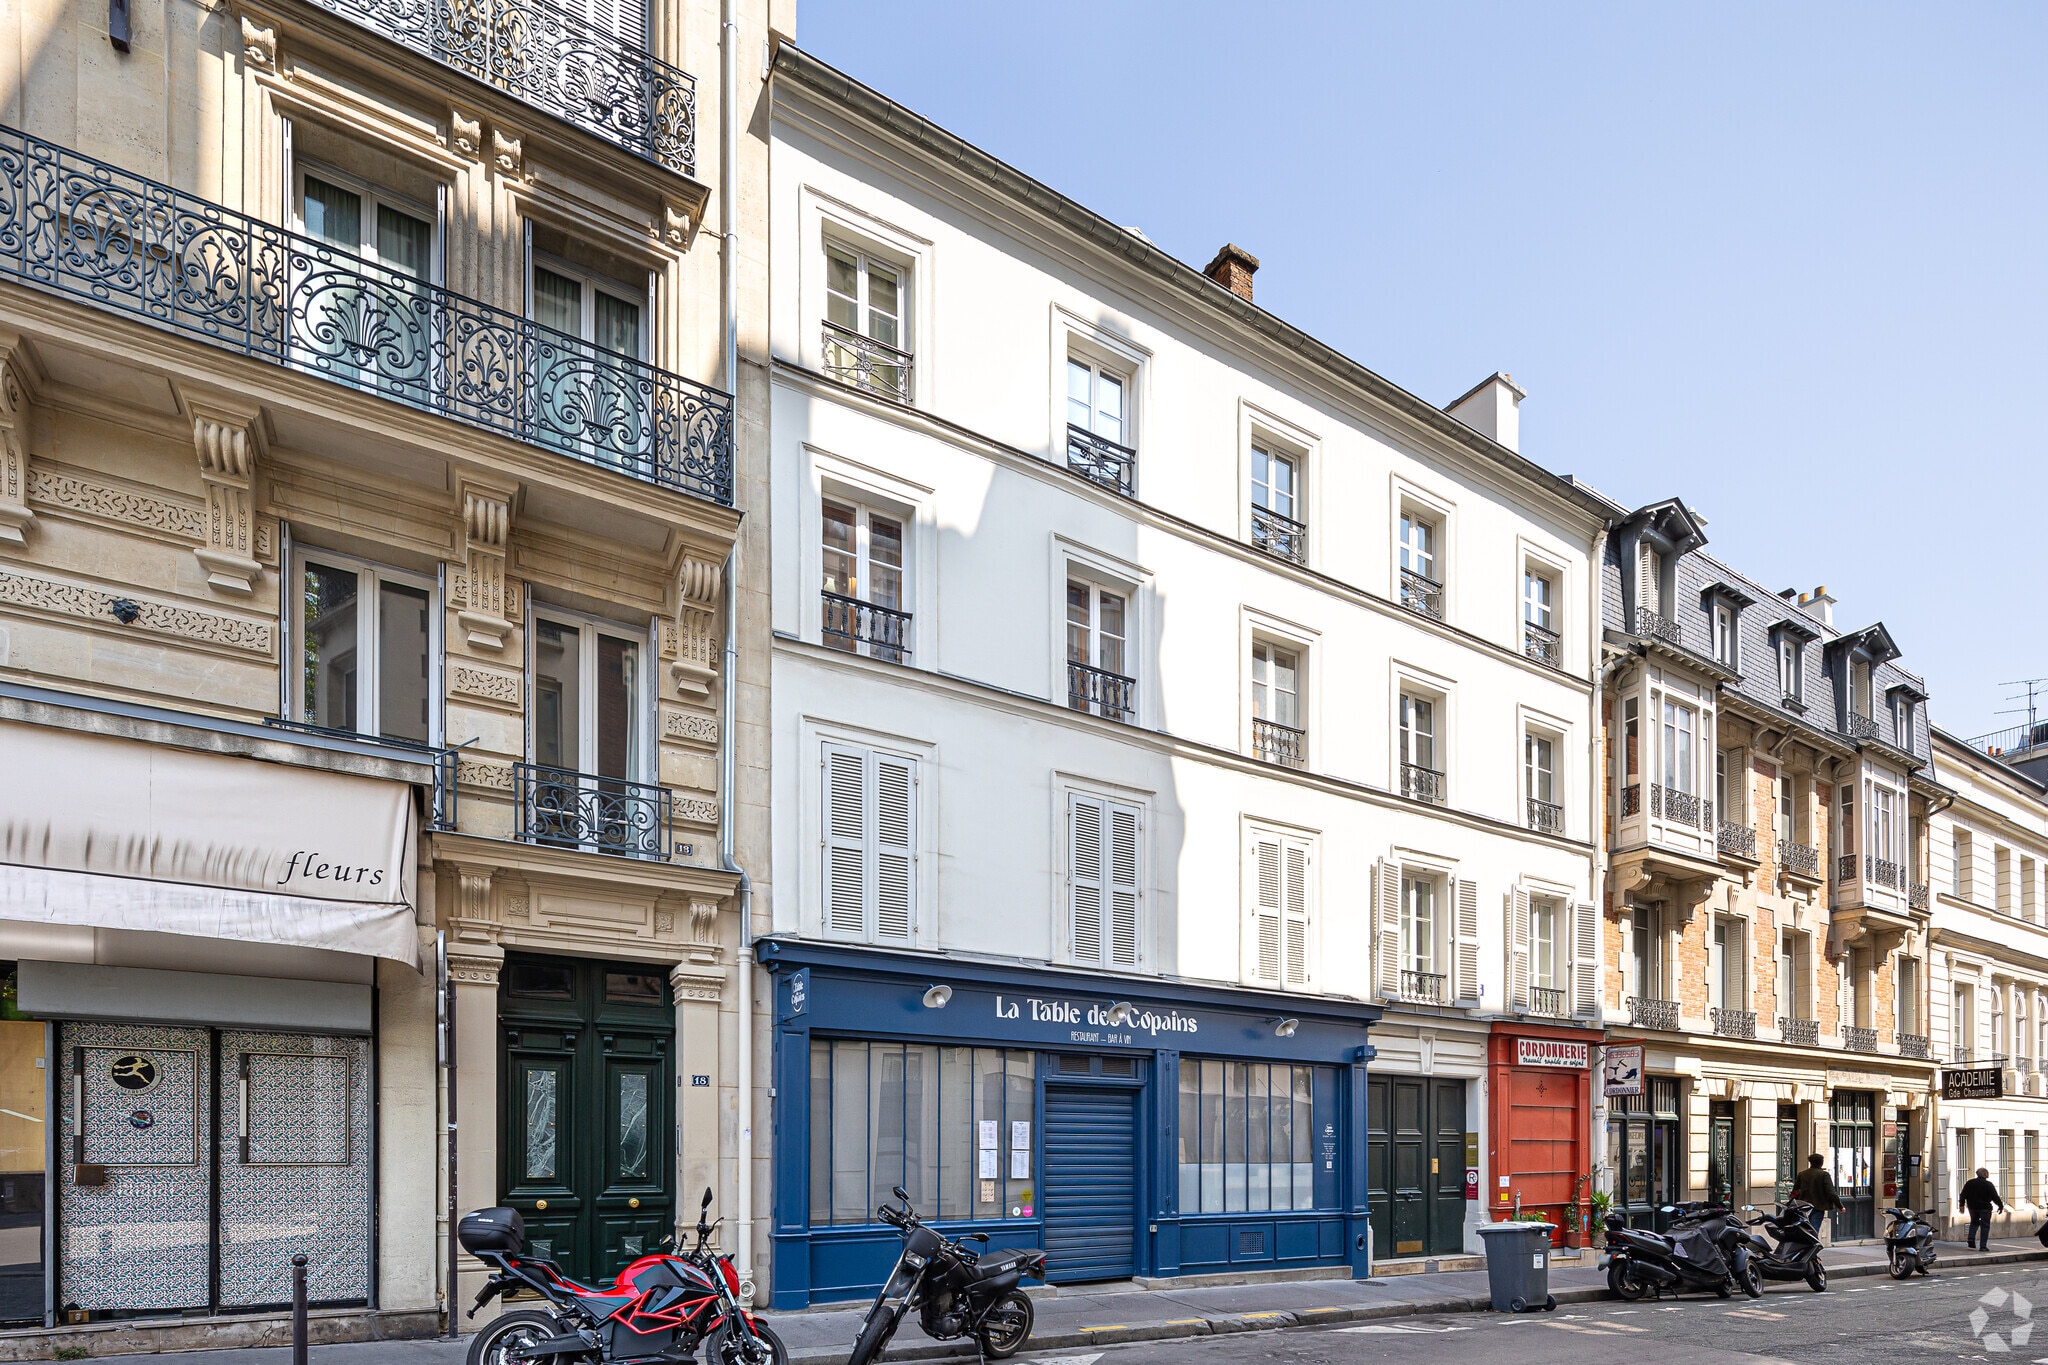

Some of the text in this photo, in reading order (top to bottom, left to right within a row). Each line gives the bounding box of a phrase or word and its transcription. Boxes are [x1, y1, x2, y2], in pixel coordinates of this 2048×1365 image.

[277, 851, 384, 885] fleurs
[996, 996, 1198, 1036] La Table de Copains
[1070, 1031, 1100, 1043] RESTAURANT
[1107, 1033, 1118, 1045] BAR
[1124, 1034, 1132, 1045] VIN
[1520, 1041, 1586, 1060] CORDONNERIE
[694, 1076, 707, 1085] 18
[1948, 1070, 1996, 1088] ACADEMIE
[1606, 1086, 1640, 1095] CORDONNIER
[1948, 1087, 1996, 1098] Gde Chaumière
[1000, 1261, 1017, 1272] YAMAHA
